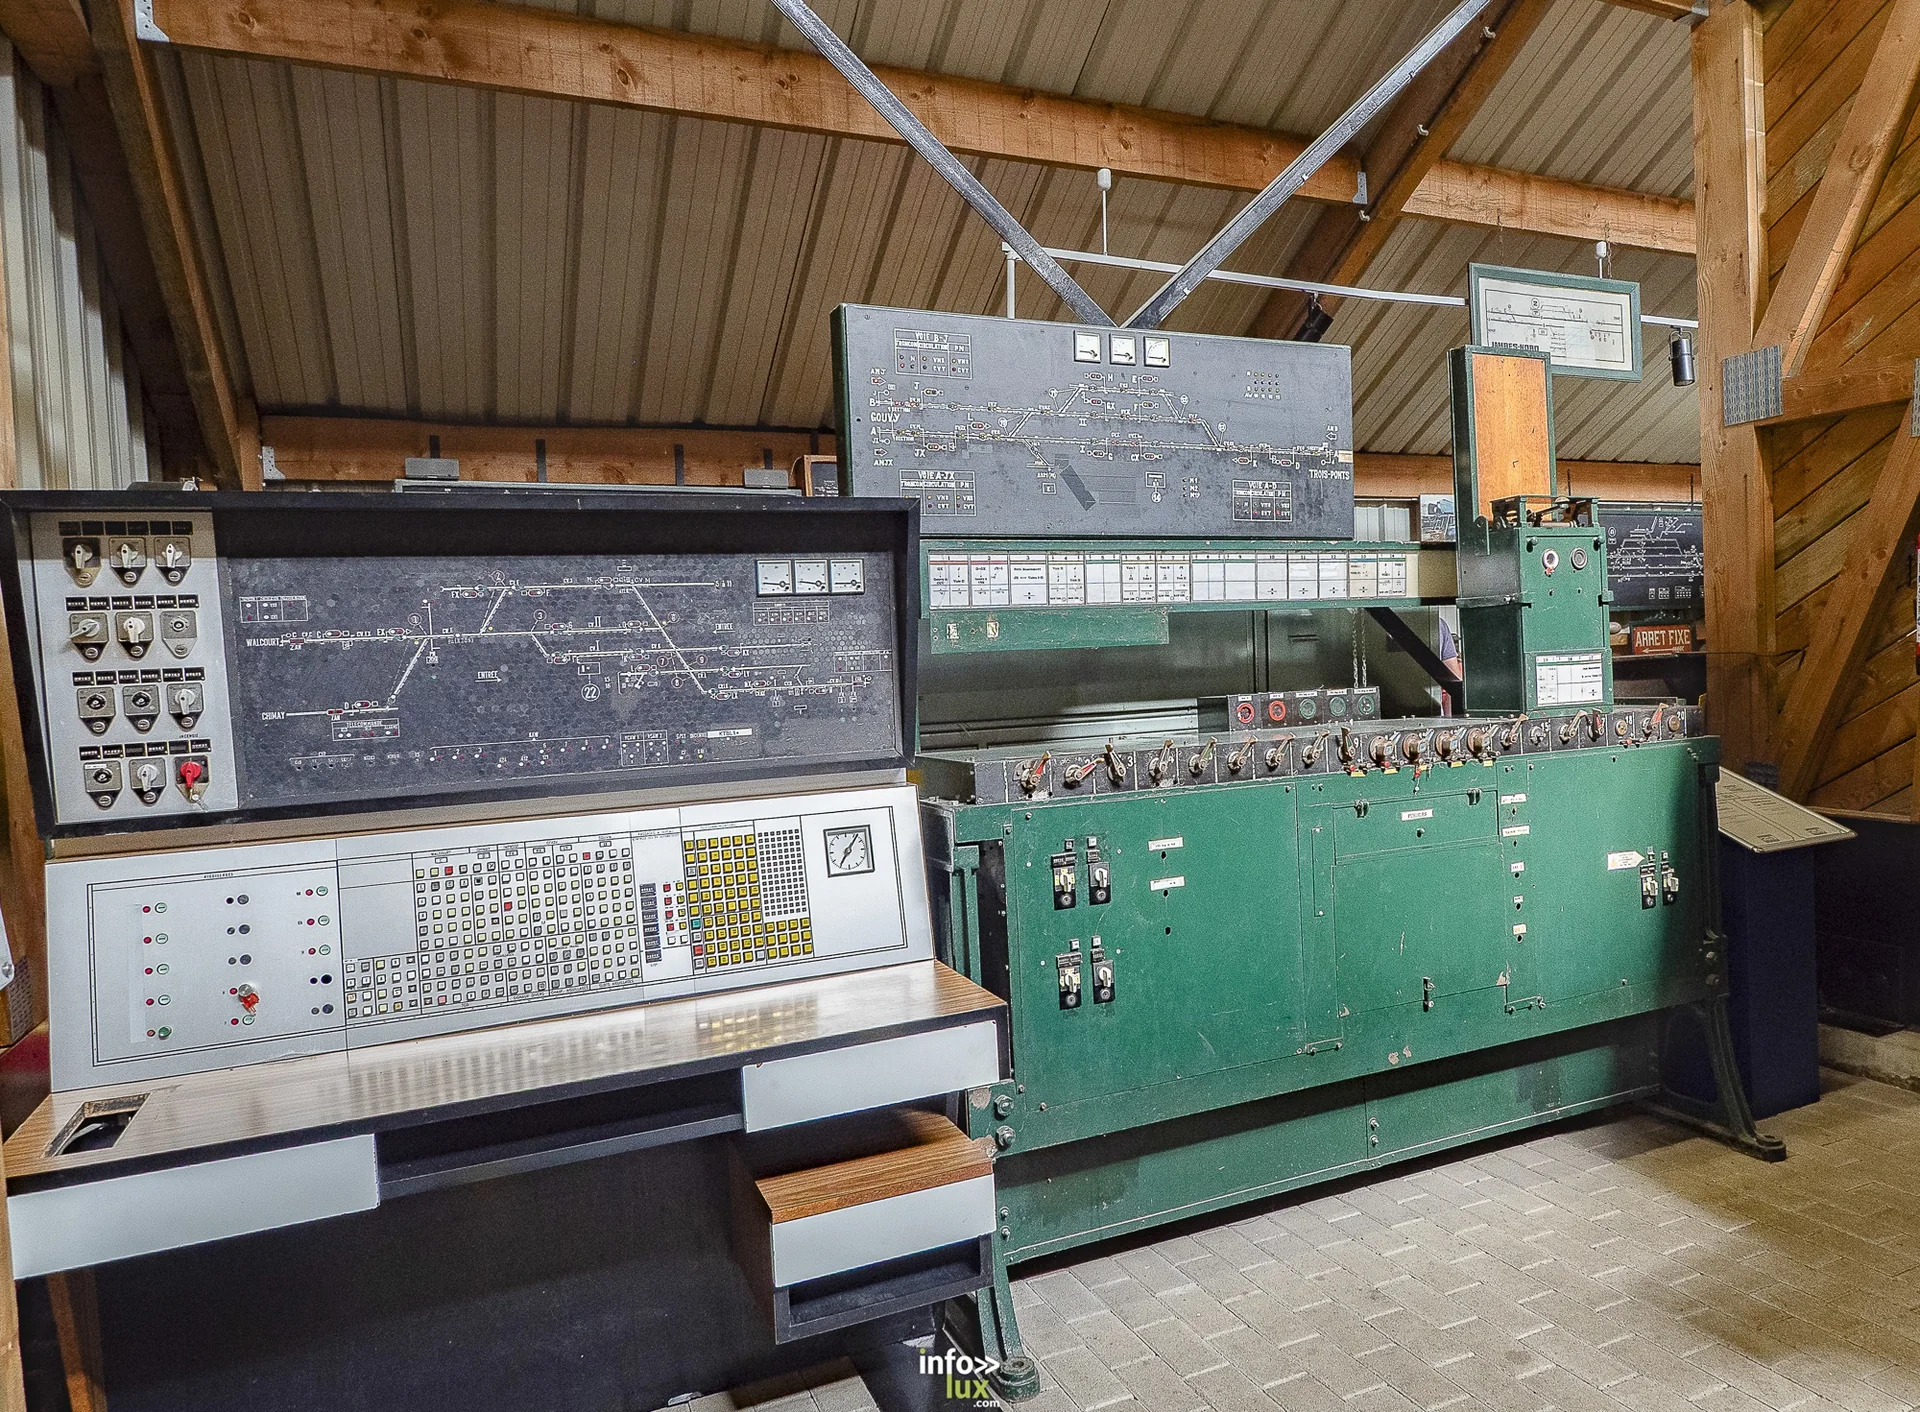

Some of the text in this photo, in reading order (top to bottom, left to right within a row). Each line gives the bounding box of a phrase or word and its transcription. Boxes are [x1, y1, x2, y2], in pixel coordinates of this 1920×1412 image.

[915, 332, 930, 341] VOIE
[870, 412, 900, 422] GOUVY
[914, 448, 926, 458] JX
[918, 470, 934, 480] VOIE
[1308, 468, 1350, 480] TROIS-PONTS
[246, 638, 280, 647] WALCOURT
[1636, 630, 1690, 647] ARRET FIXE
[477, 670, 499, 680] ENTREE
[261, 712, 286, 720] CHIMAY
[1624, 715, 1633, 724] 18
[1676, 710, 1685, 720] 20
[1354, 738, 1360, 748] 9
[1128, 756, 1134, 768] 3
